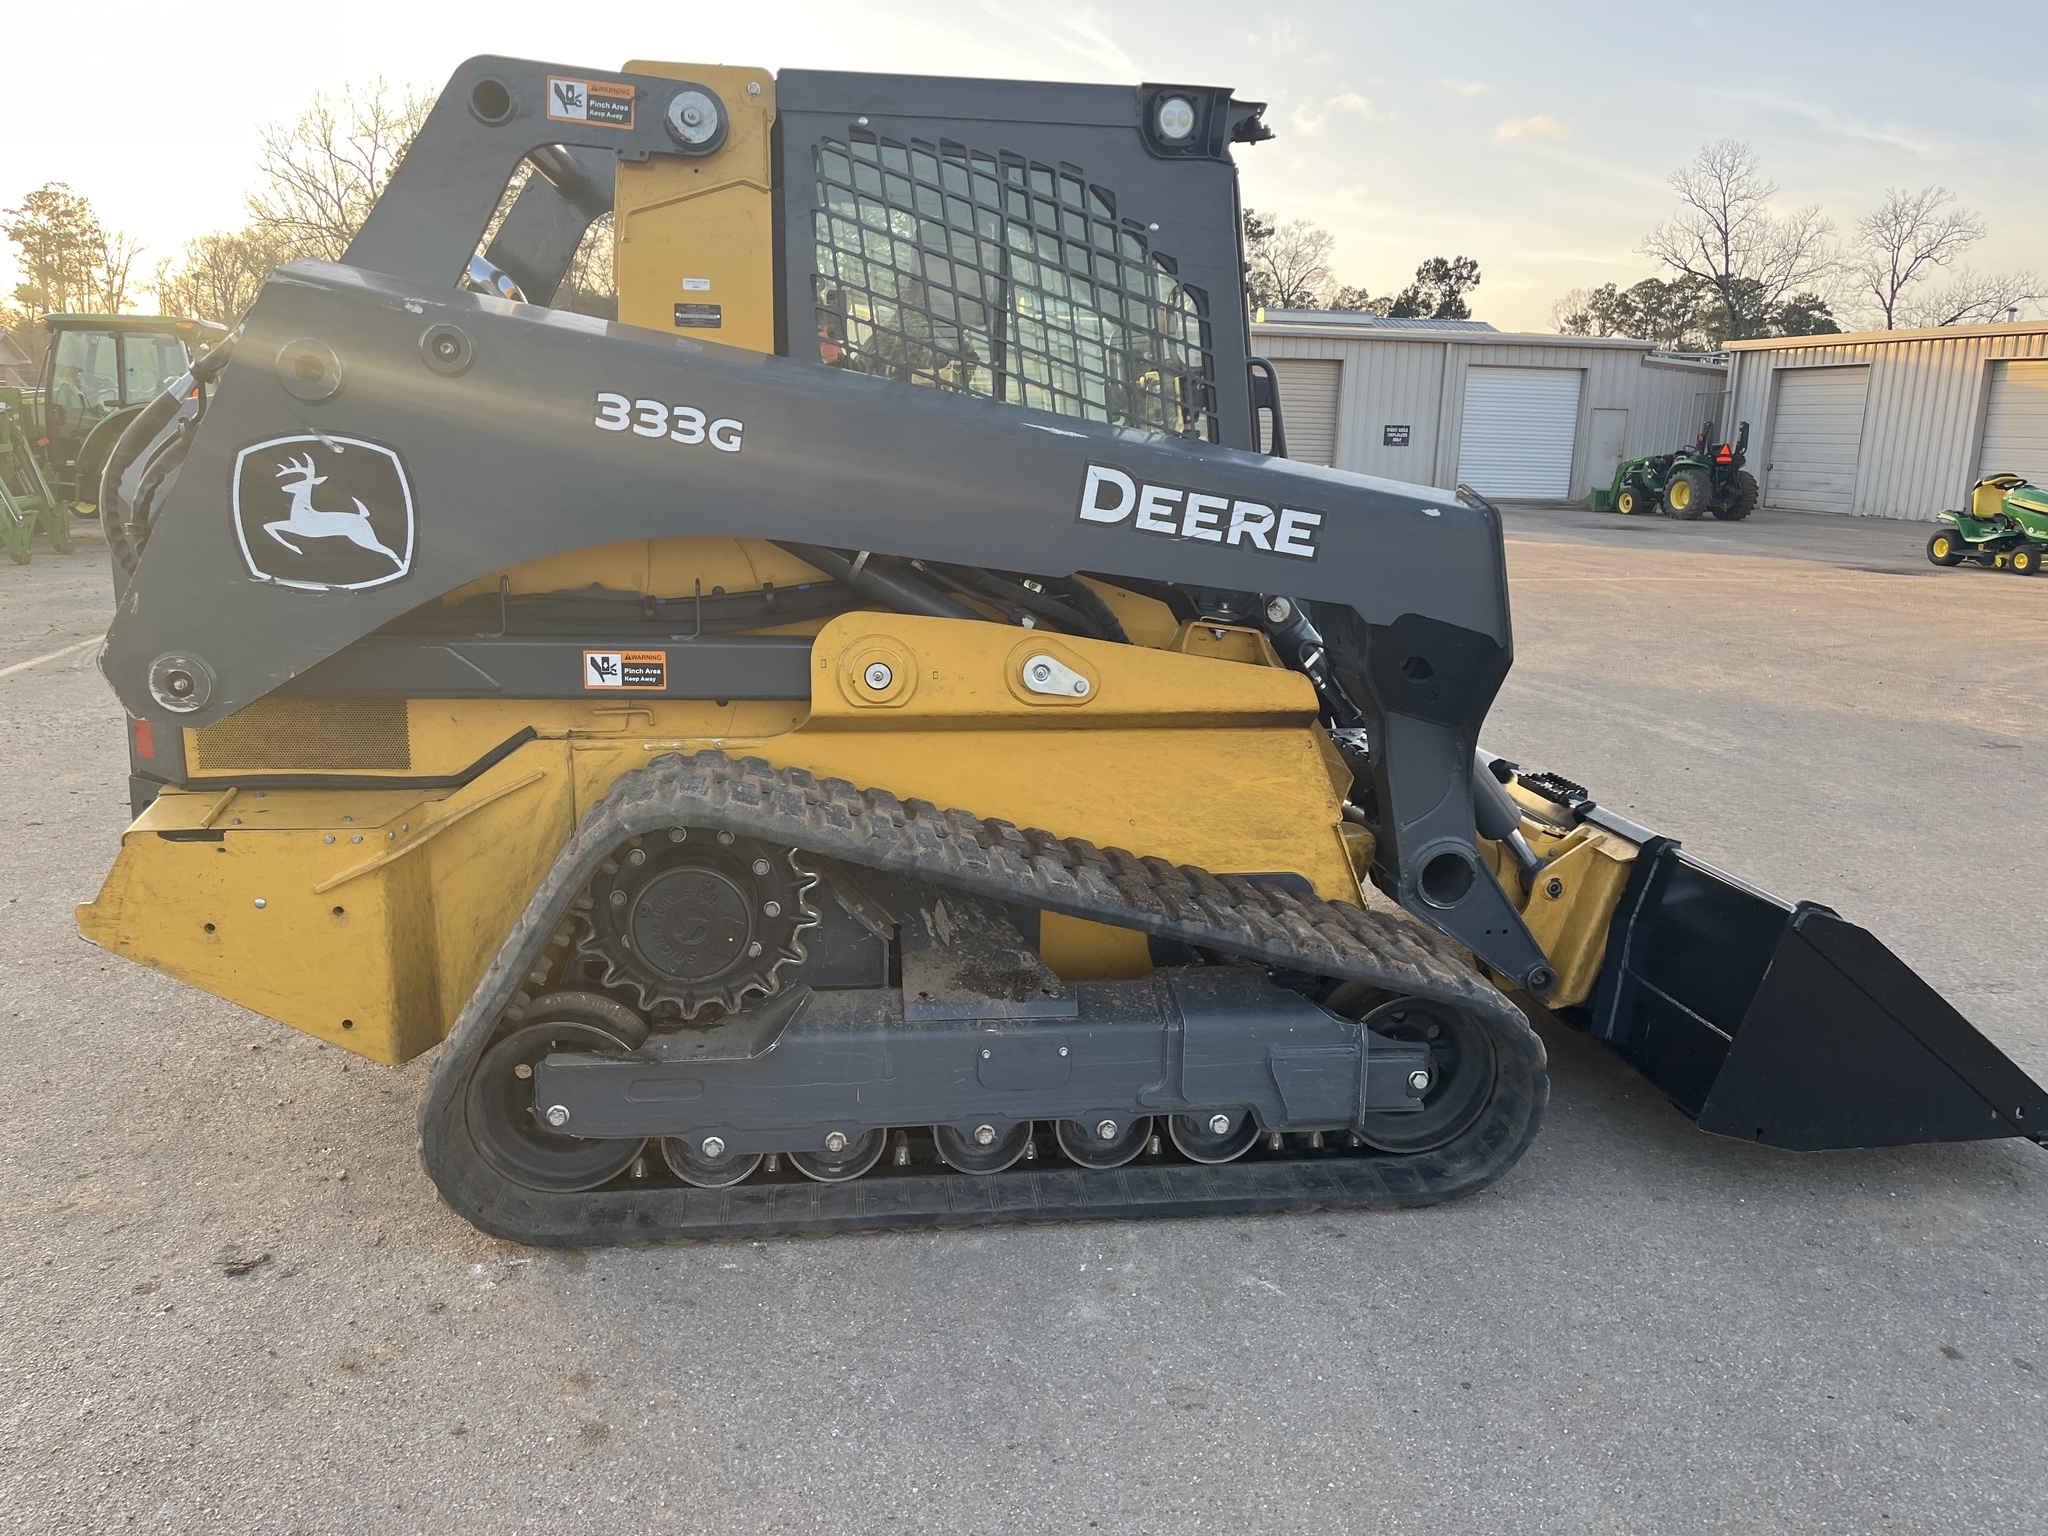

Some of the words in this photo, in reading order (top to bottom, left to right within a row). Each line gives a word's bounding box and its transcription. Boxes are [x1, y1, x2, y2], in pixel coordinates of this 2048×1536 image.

[597, 86, 631, 96] WARNING
[589, 100, 610, 109] Pinch
[611, 102, 629, 111] Area
[589, 110, 605, 118] Keep
[606, 112, 623, 120] Away
[594, 392, 743, 452] 333G
[1079, 464, 1322, 558] DEERE
[624, 667, 644, 675] Pinch
[645, 667, 661, 675] Area
